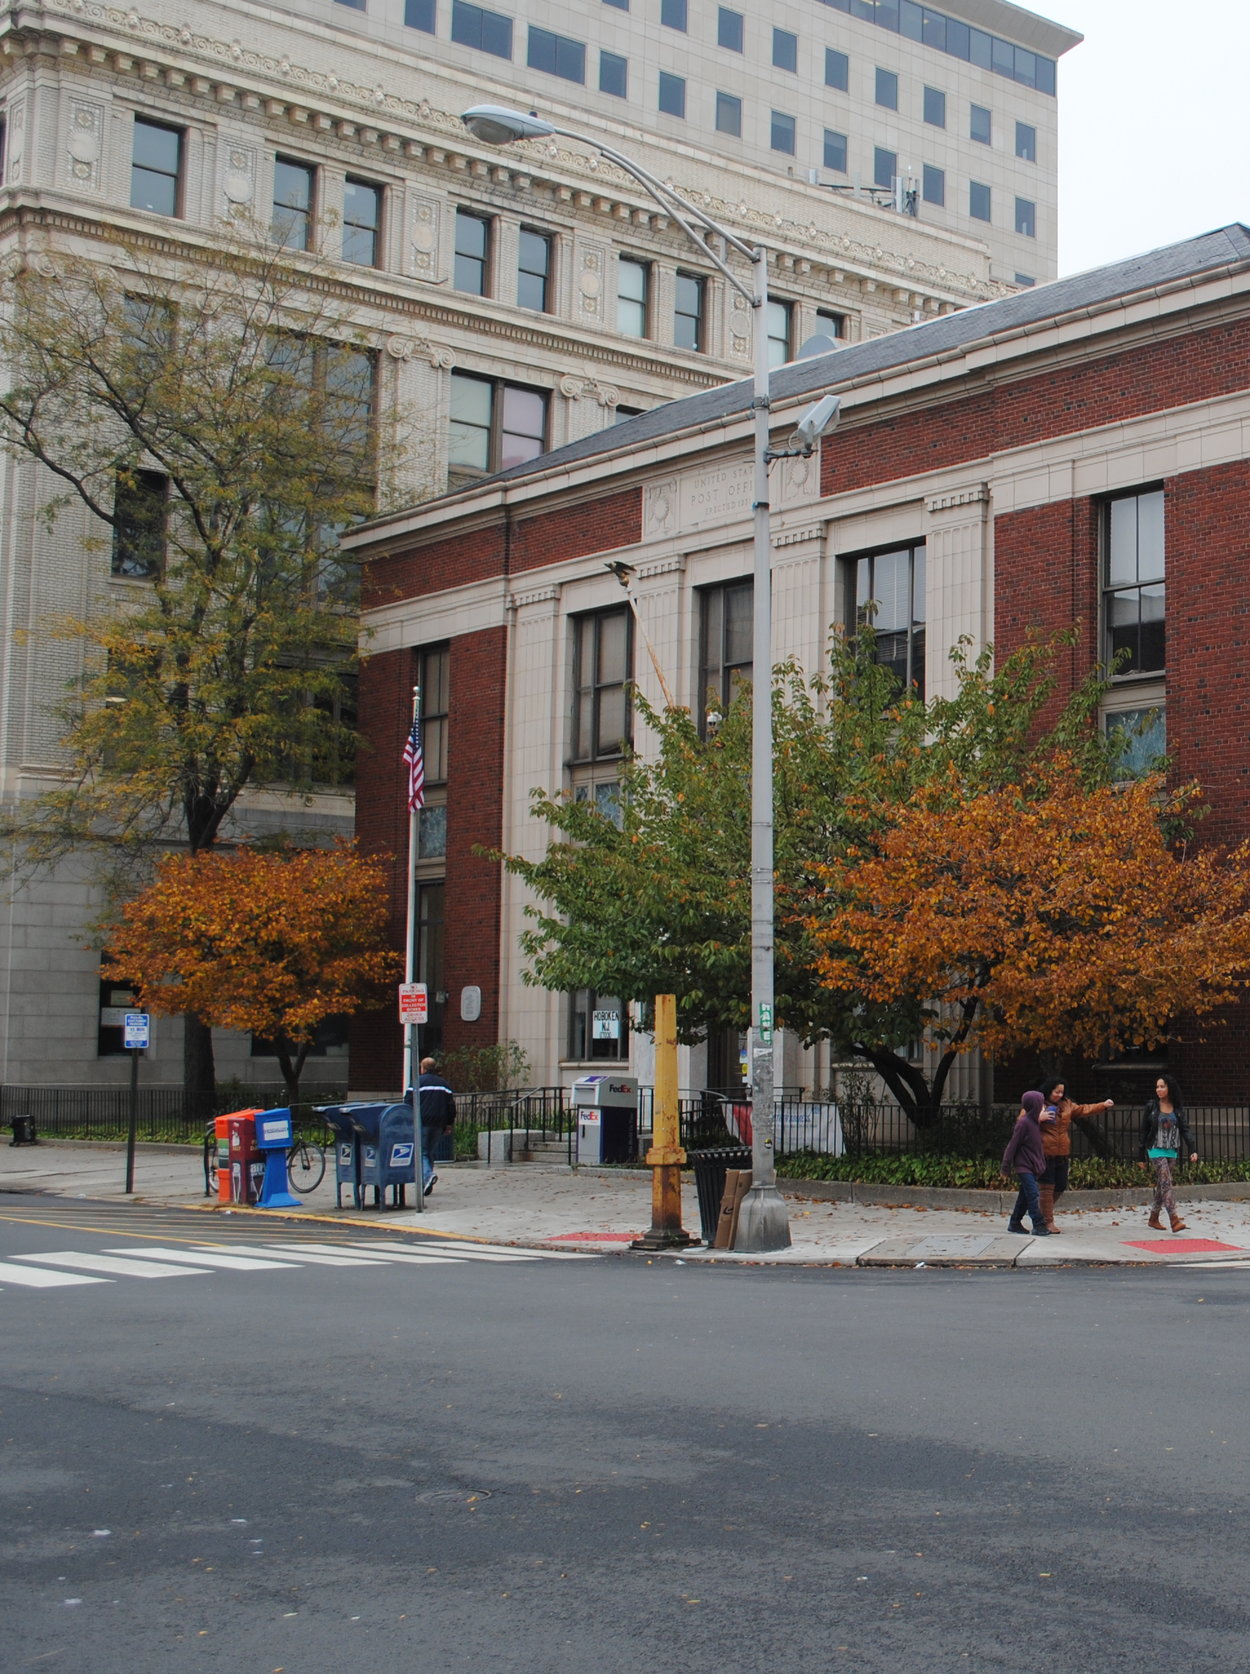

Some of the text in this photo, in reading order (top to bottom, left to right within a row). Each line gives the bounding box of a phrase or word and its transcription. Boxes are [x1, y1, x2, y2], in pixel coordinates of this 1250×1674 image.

[695, 465, 754, 489] UNITED STAT
[691, 480, 754, 506] POST OFFI
[594, 1011, 620, 1021] HOBOKEN
[609, 1084, 634, 1094] FedEx
[580, 1111, 599, 1121] FedEx
